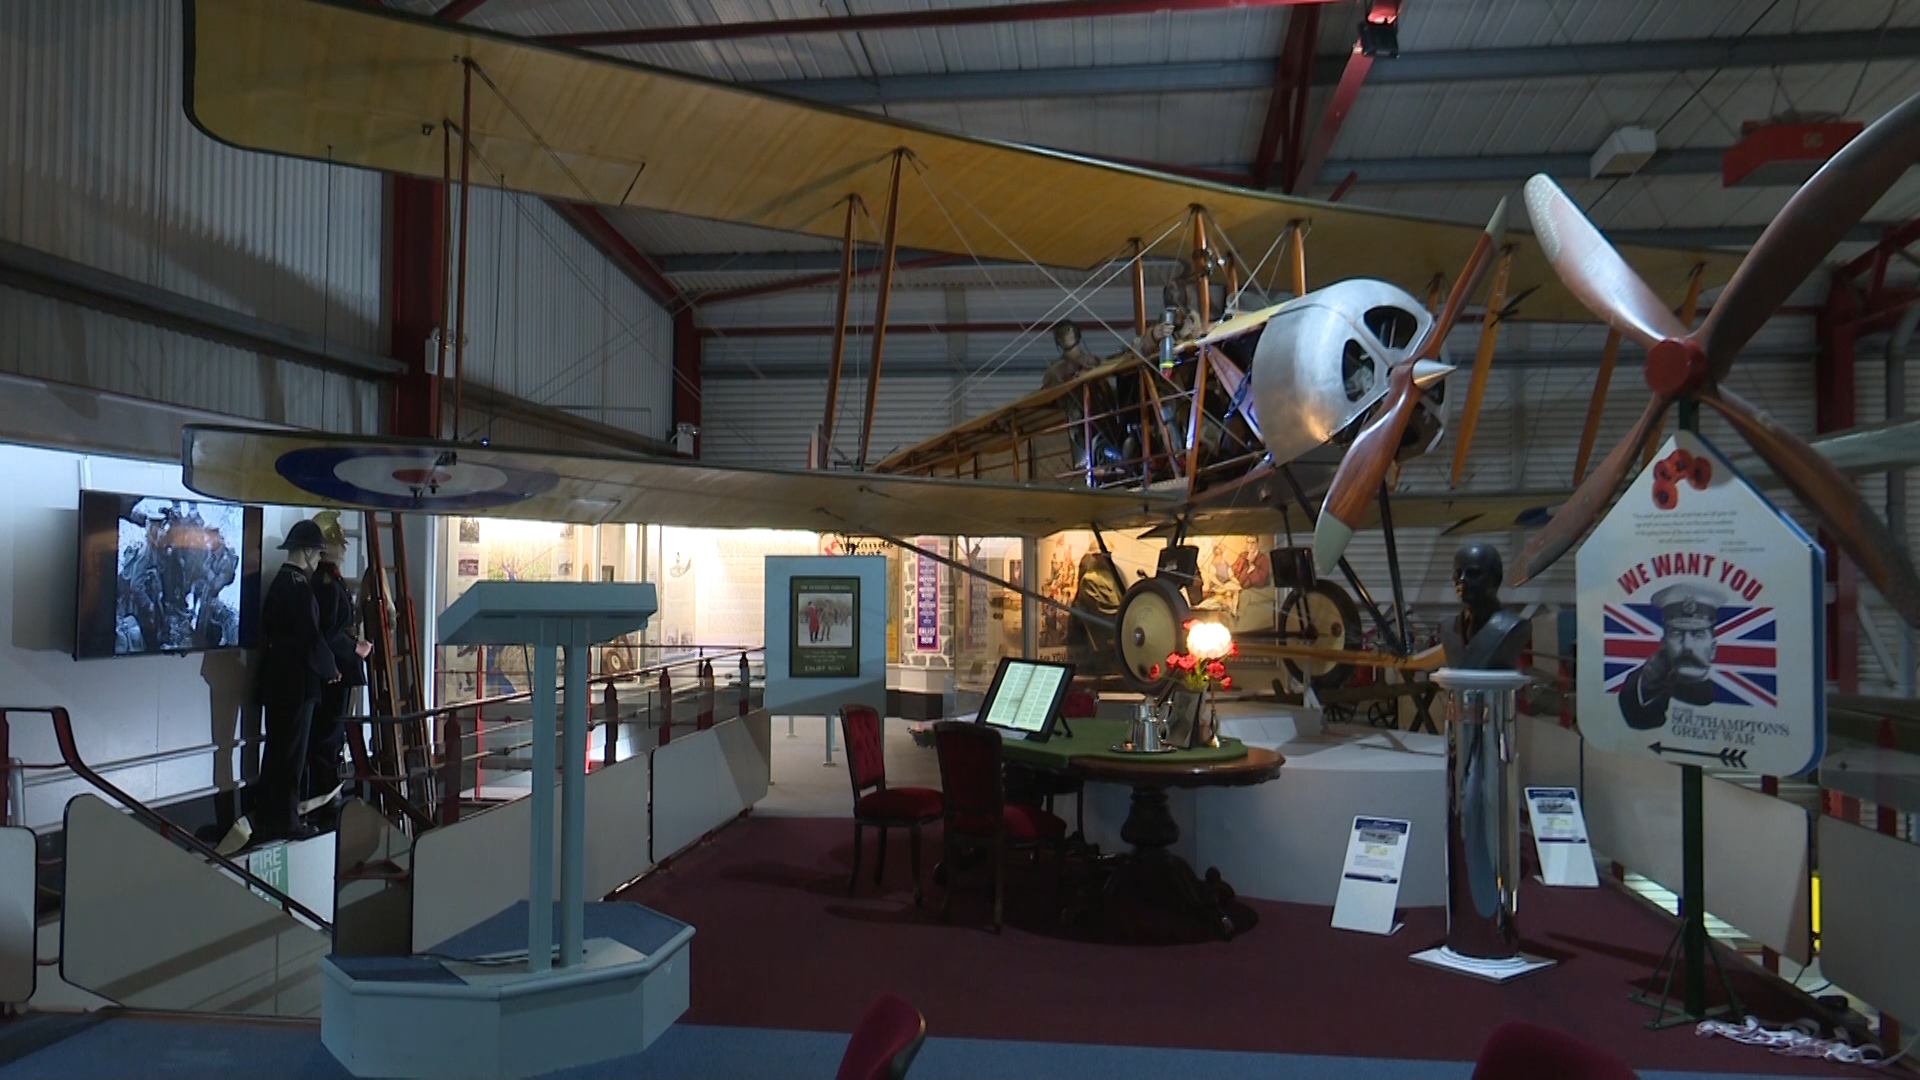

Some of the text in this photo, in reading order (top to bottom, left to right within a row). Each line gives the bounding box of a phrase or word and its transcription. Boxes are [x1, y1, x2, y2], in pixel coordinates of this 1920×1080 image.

[1617, 551, 1763, 602] WE WANT YOU
[1672, 725, 1755, 745] GREAT WAR
[251, 847, 282, 870] FIRE
